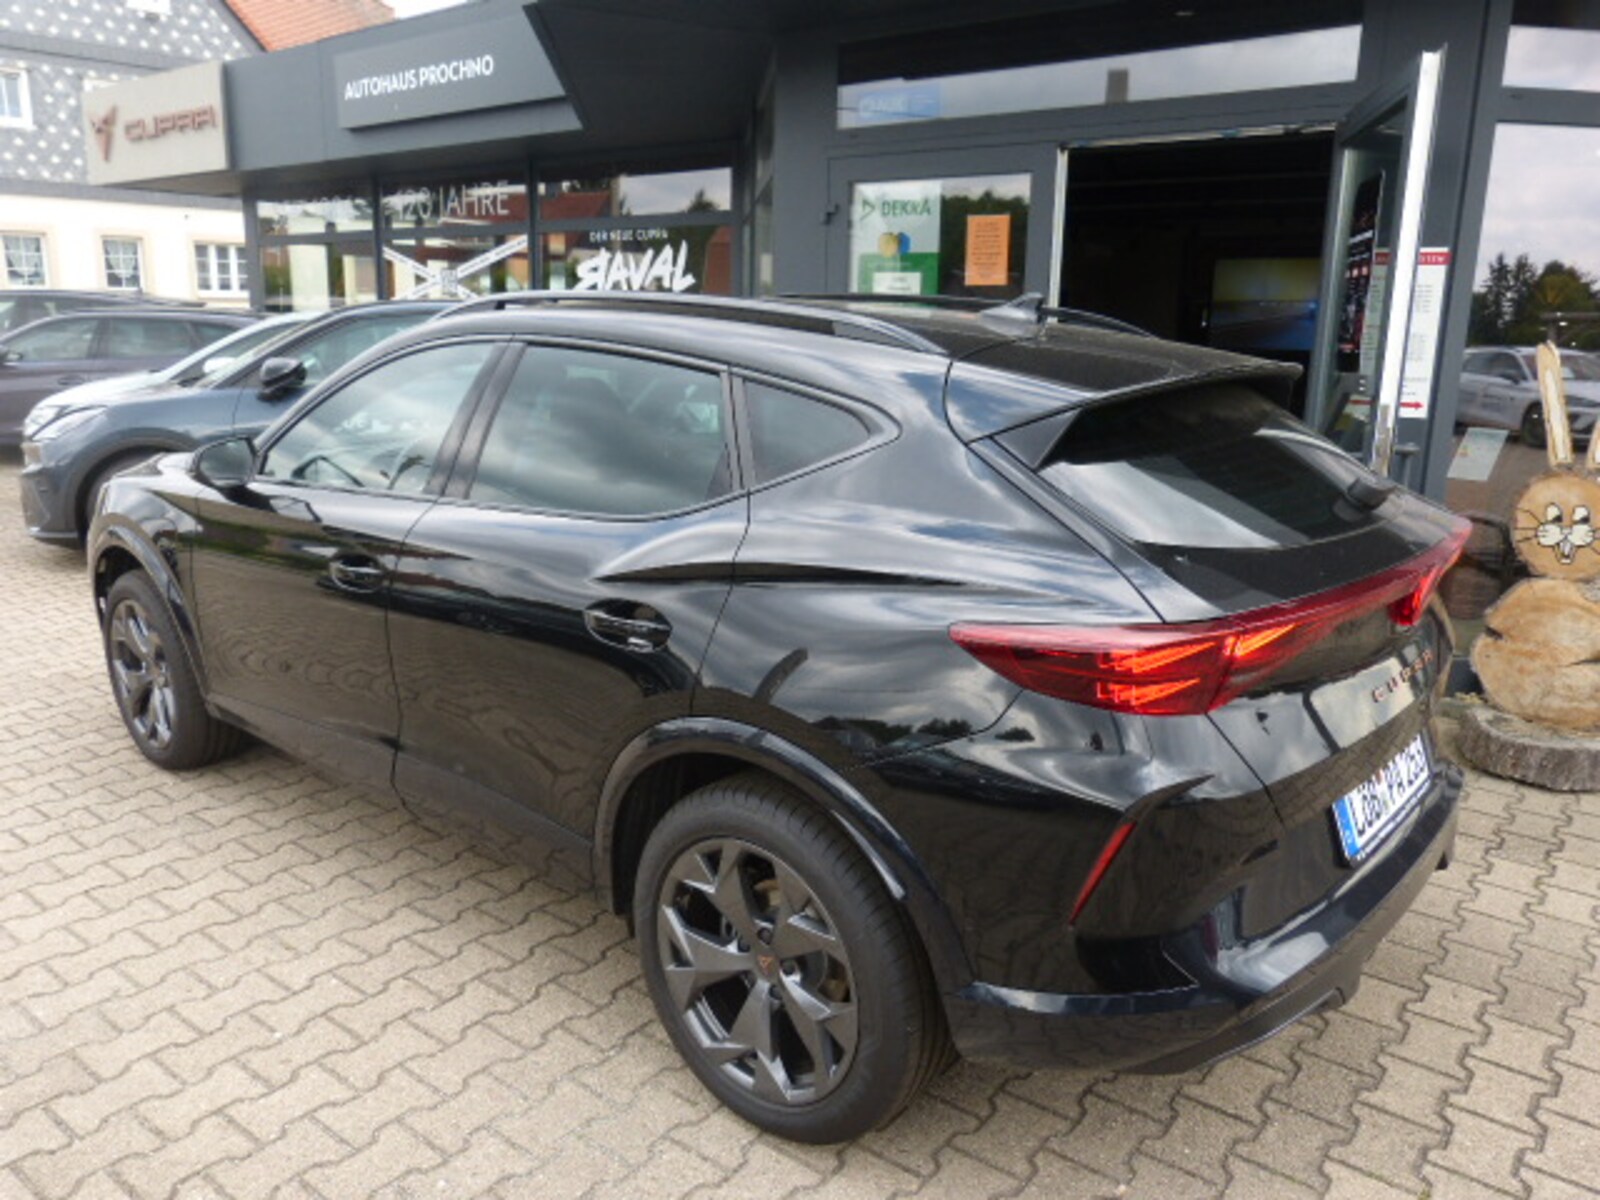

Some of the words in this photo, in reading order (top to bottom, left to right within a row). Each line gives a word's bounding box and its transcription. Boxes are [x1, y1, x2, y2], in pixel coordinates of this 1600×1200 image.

[344, 68, 417, 101] AUTOHAUS
[419, 53, 494, 88] PROCHNO
[123, 104, 217, 142] CUPRA
[438, 180, 511, 219] JAHRE
[572, 239, 696, 293] RAVAL
